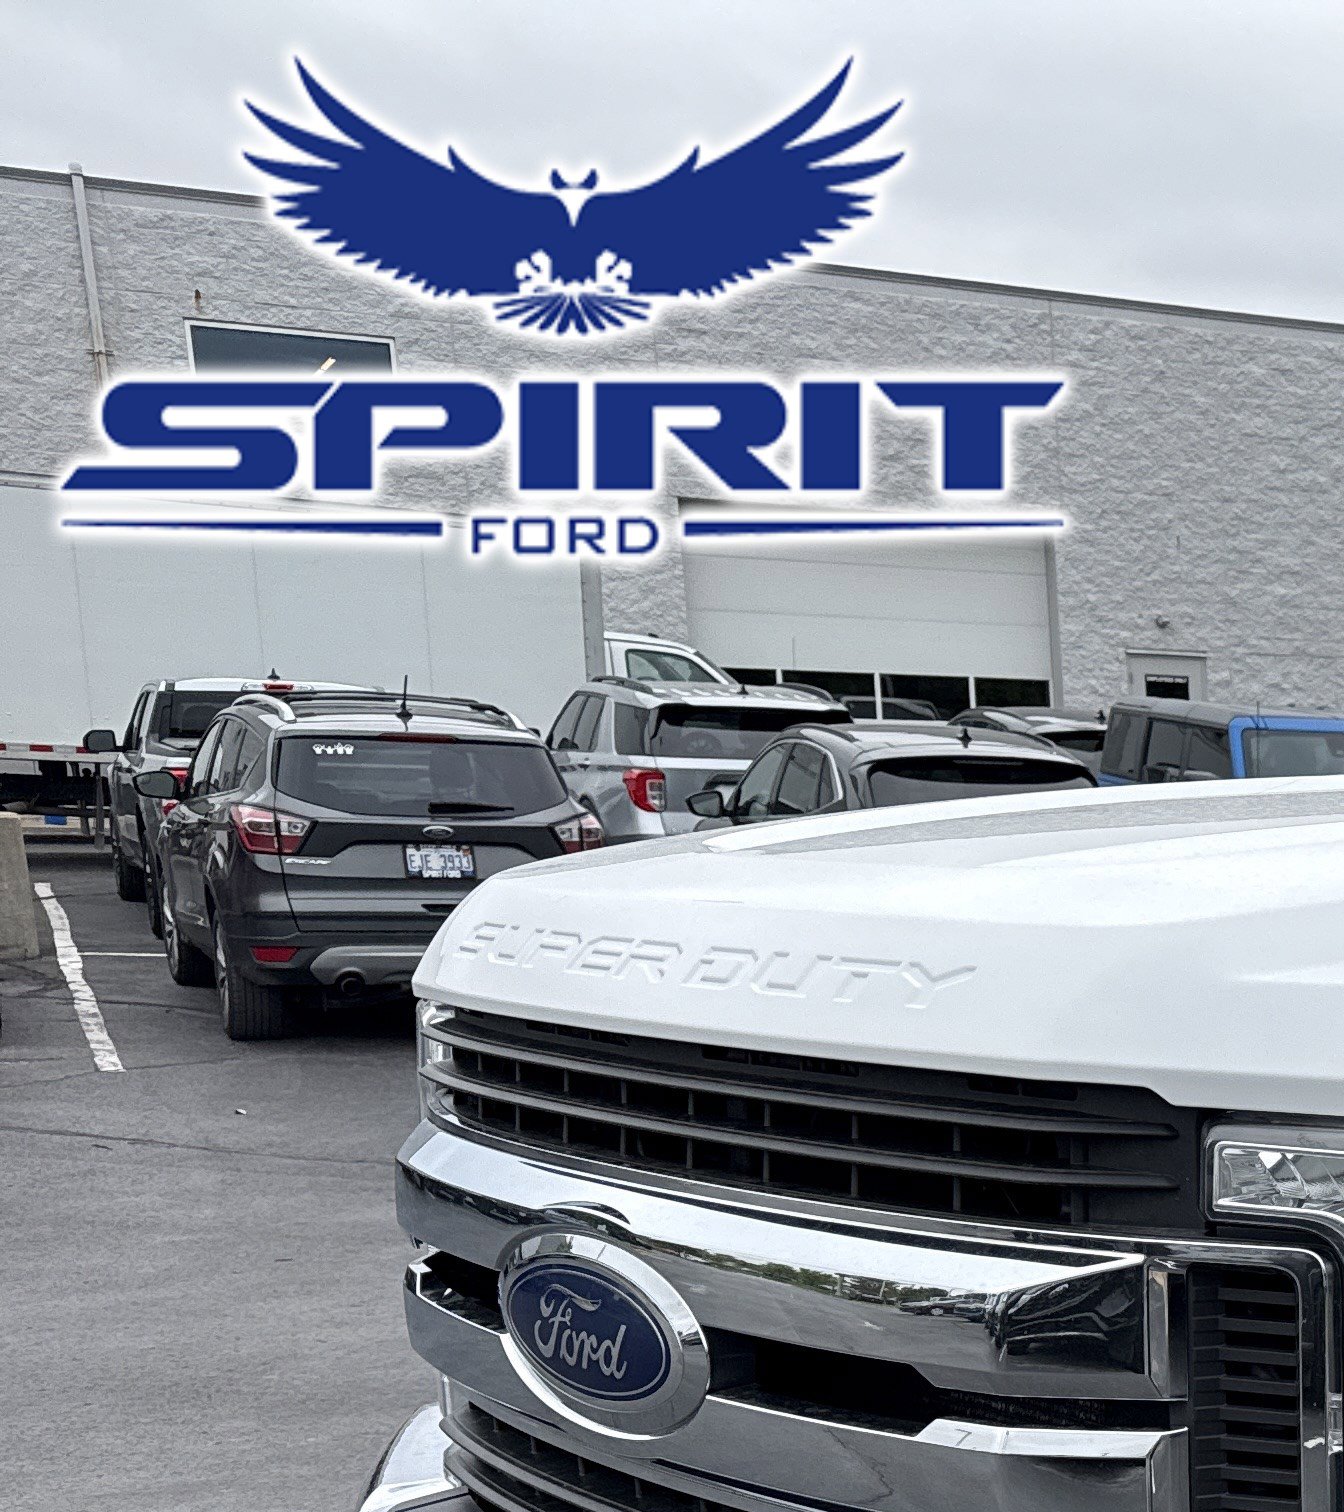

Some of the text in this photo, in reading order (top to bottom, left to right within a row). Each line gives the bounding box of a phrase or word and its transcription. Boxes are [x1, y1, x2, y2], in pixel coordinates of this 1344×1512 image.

[457, 920, 978, 1009] SUPER DUTY
[534, 1283, 628, 1379] Ford
